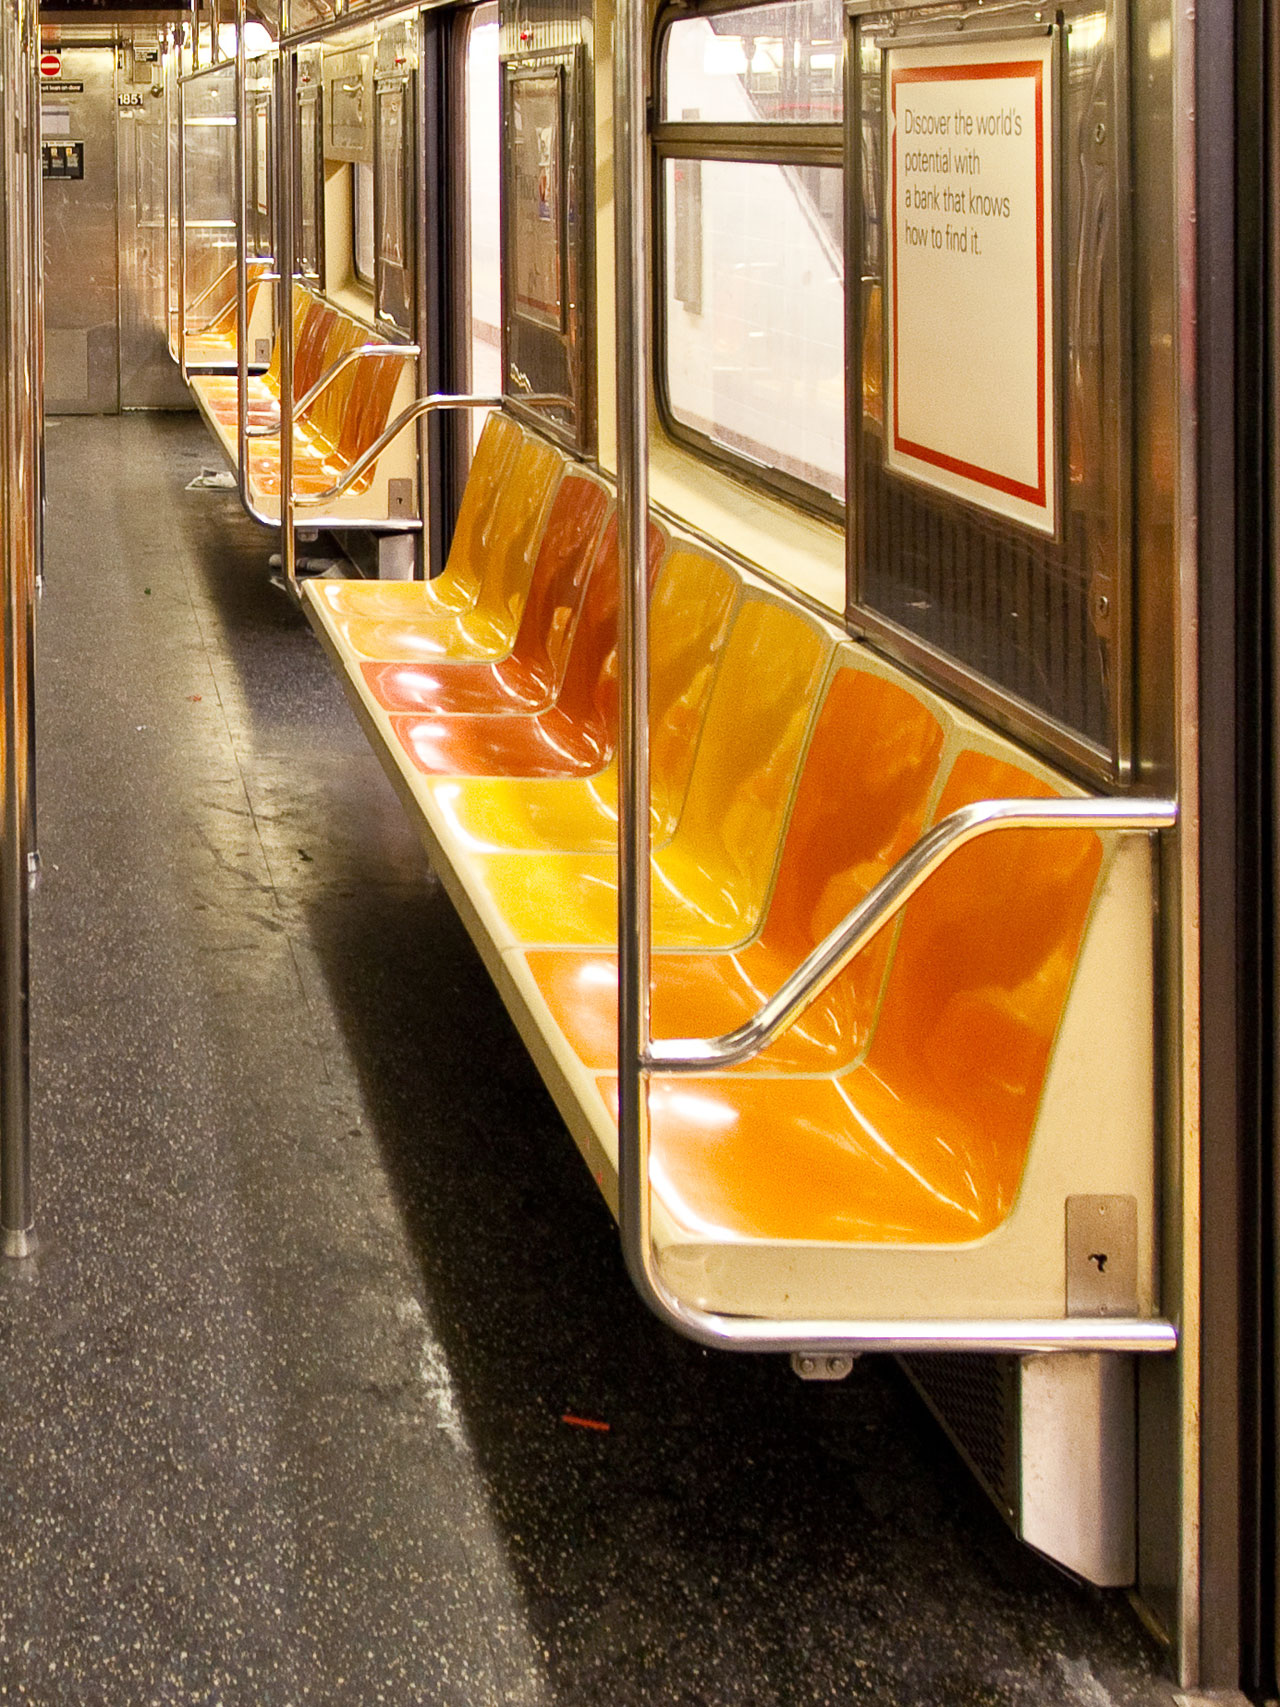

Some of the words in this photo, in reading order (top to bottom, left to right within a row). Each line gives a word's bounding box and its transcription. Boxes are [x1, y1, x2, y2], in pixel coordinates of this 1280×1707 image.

[118, 93, 143, 105] 1851
[905, 108, 951, 134] Discover
[954, 109, 973, 135] the
[976, 107, 1022, 136] world's
[905, 147, 951, 176] potential
[954, 147, 981, 175] with
[905, 188, 912, 208] a
[914, 184, 940, 211] bank
[943, 187, 966, 214] that
[969, 187, 1011, 218] knows
[905, 219, 928, 247] how
[931, 227, 942, 249] to
[945, 223, 968, 253] find
[970, 228, 982, 255] it.
